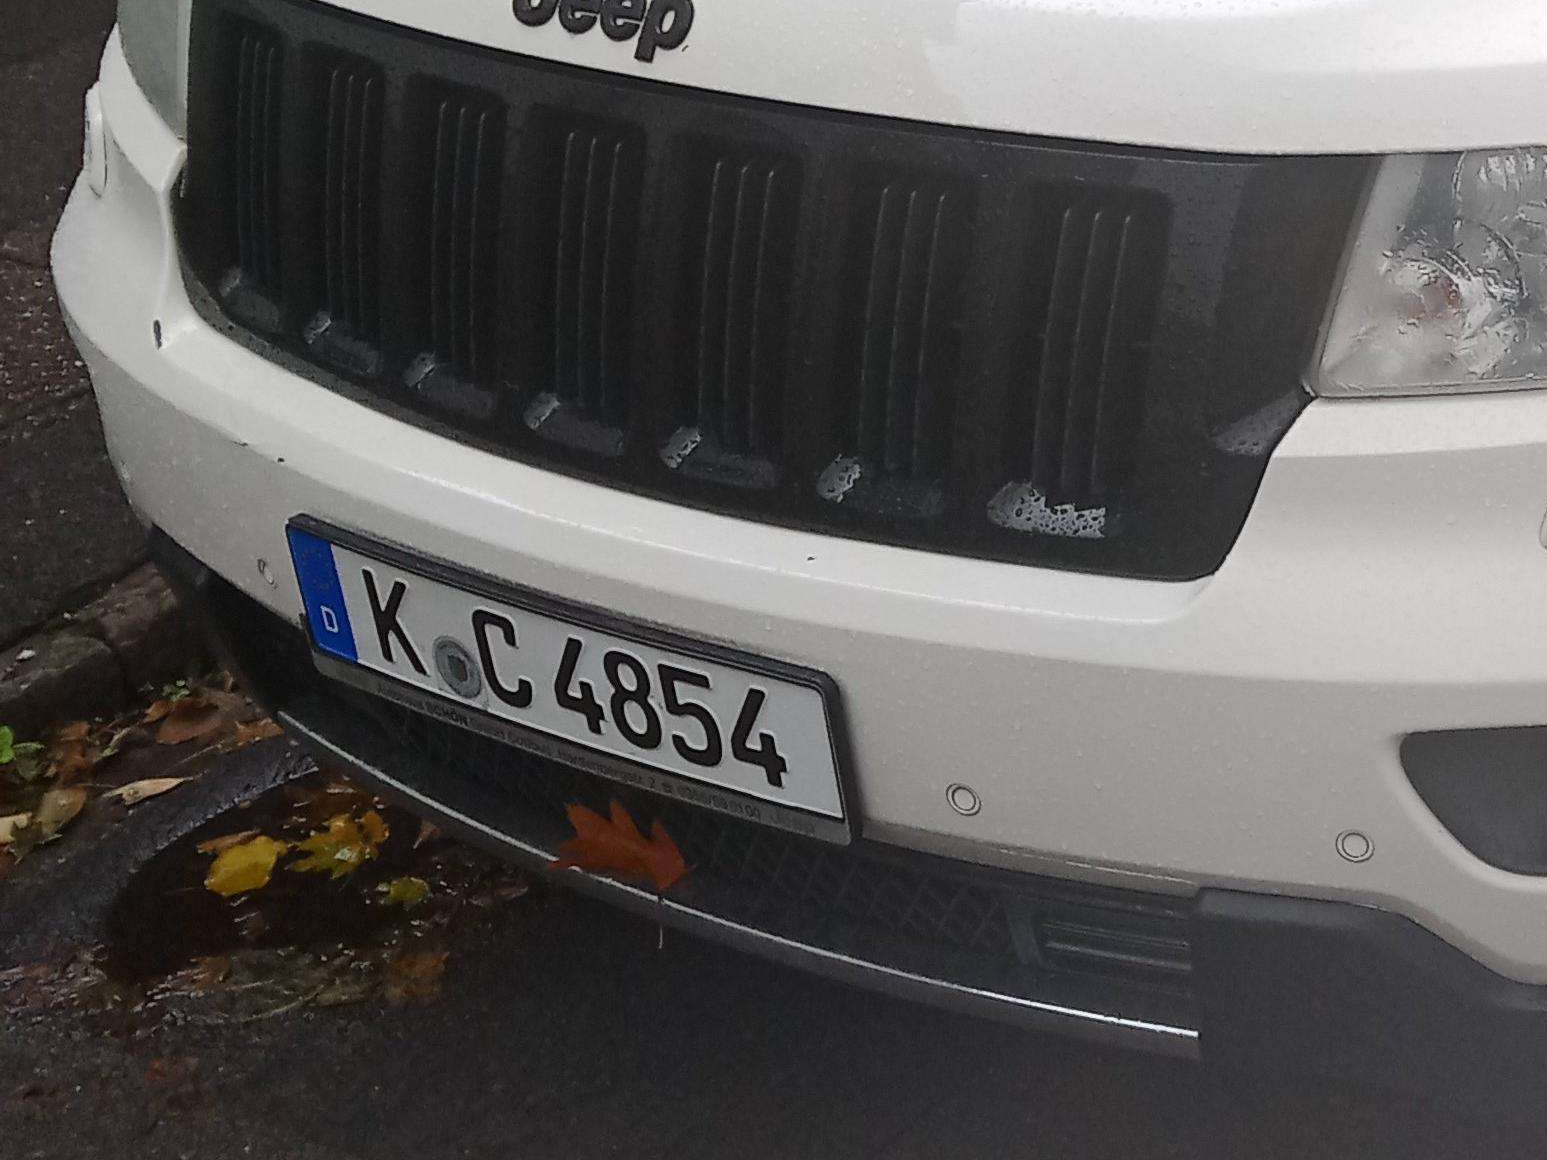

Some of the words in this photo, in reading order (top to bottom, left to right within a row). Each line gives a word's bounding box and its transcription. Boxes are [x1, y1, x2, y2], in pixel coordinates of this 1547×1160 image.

[320, 605, 339, 634] D
[361, 568, 429, 678] K
[472, 609, 533, 708] C
[554, 637, 788, 789] 4854
